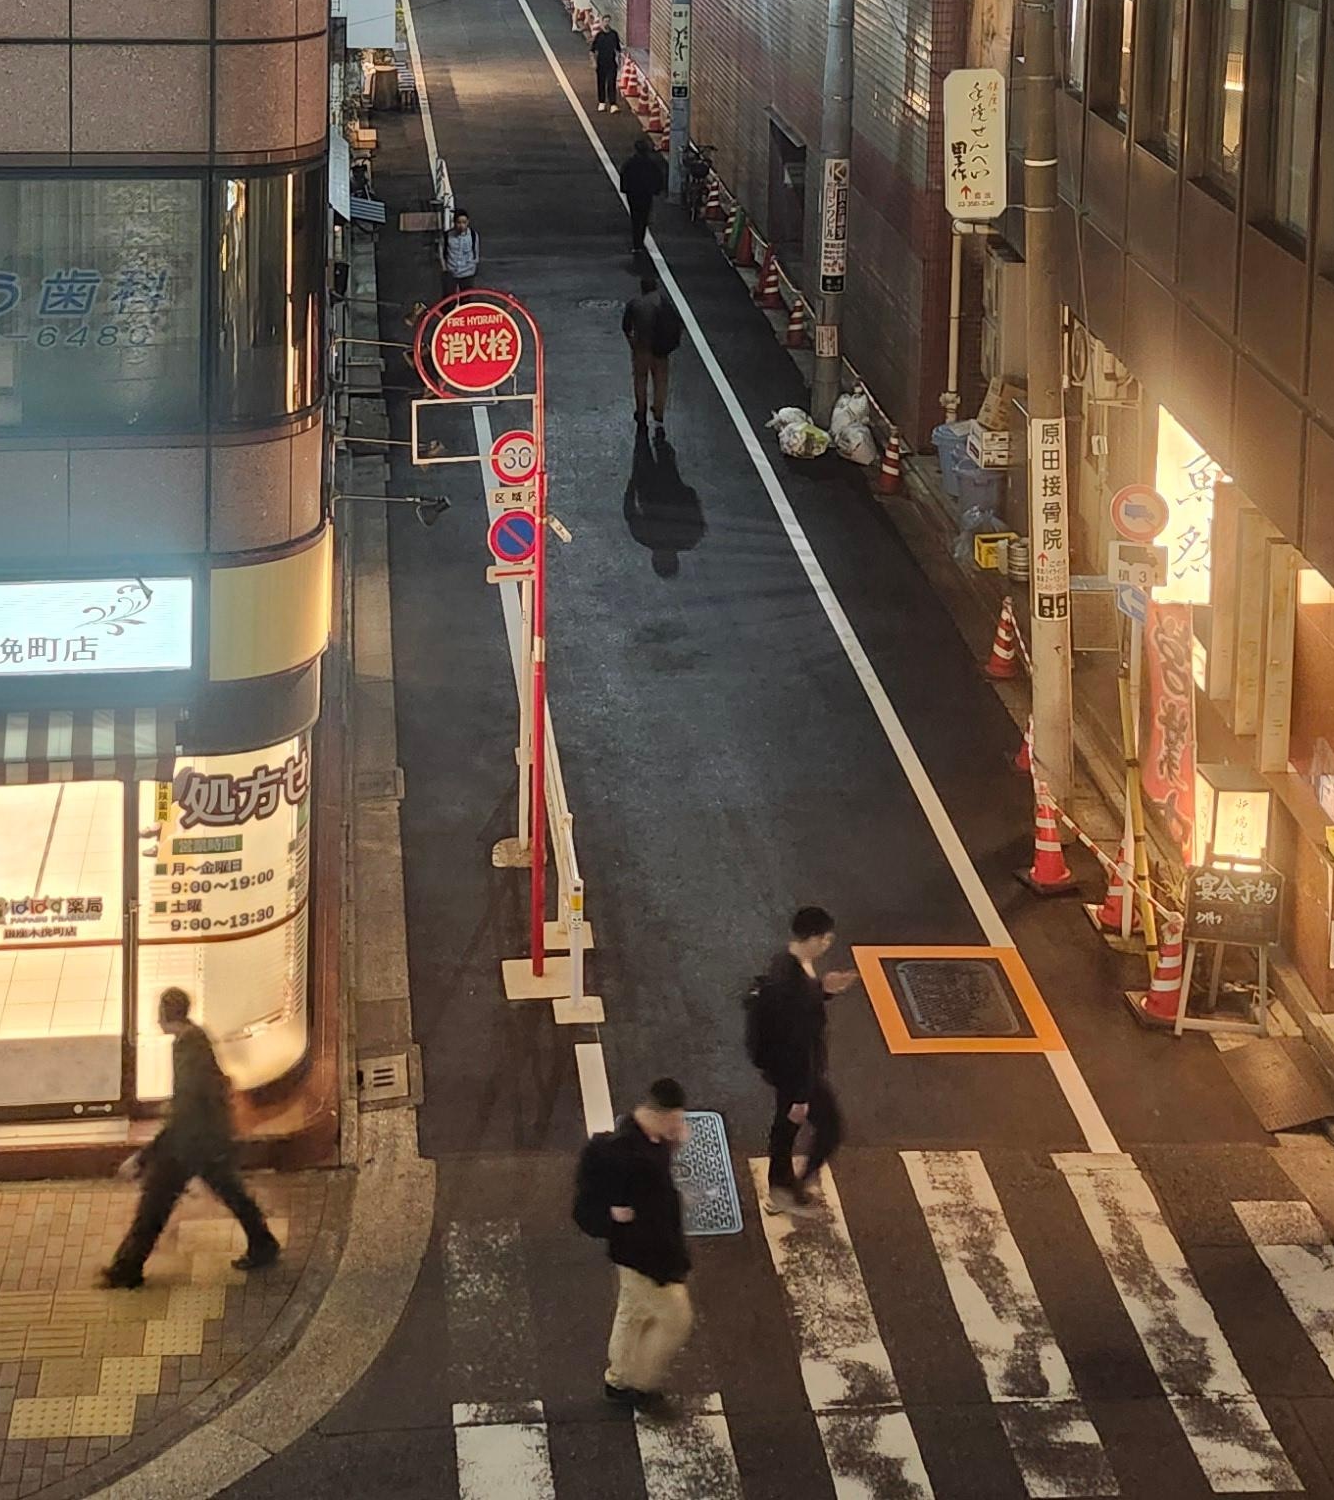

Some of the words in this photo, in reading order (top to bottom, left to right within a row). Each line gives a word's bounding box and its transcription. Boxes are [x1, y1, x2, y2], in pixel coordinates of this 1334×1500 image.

[447, 316, 465, 327] FIRE
[467, 314, 504, 326] HYDRANT
[441, 328, 514, 366] 消火栓
[503, 446, 533, 470] 30
[1041, 423, 1062, 551] 原田接骨院
[171, 869, 274, 894] 9:00～19:00
[1195, 873, 1277, 904] 宴会予約
